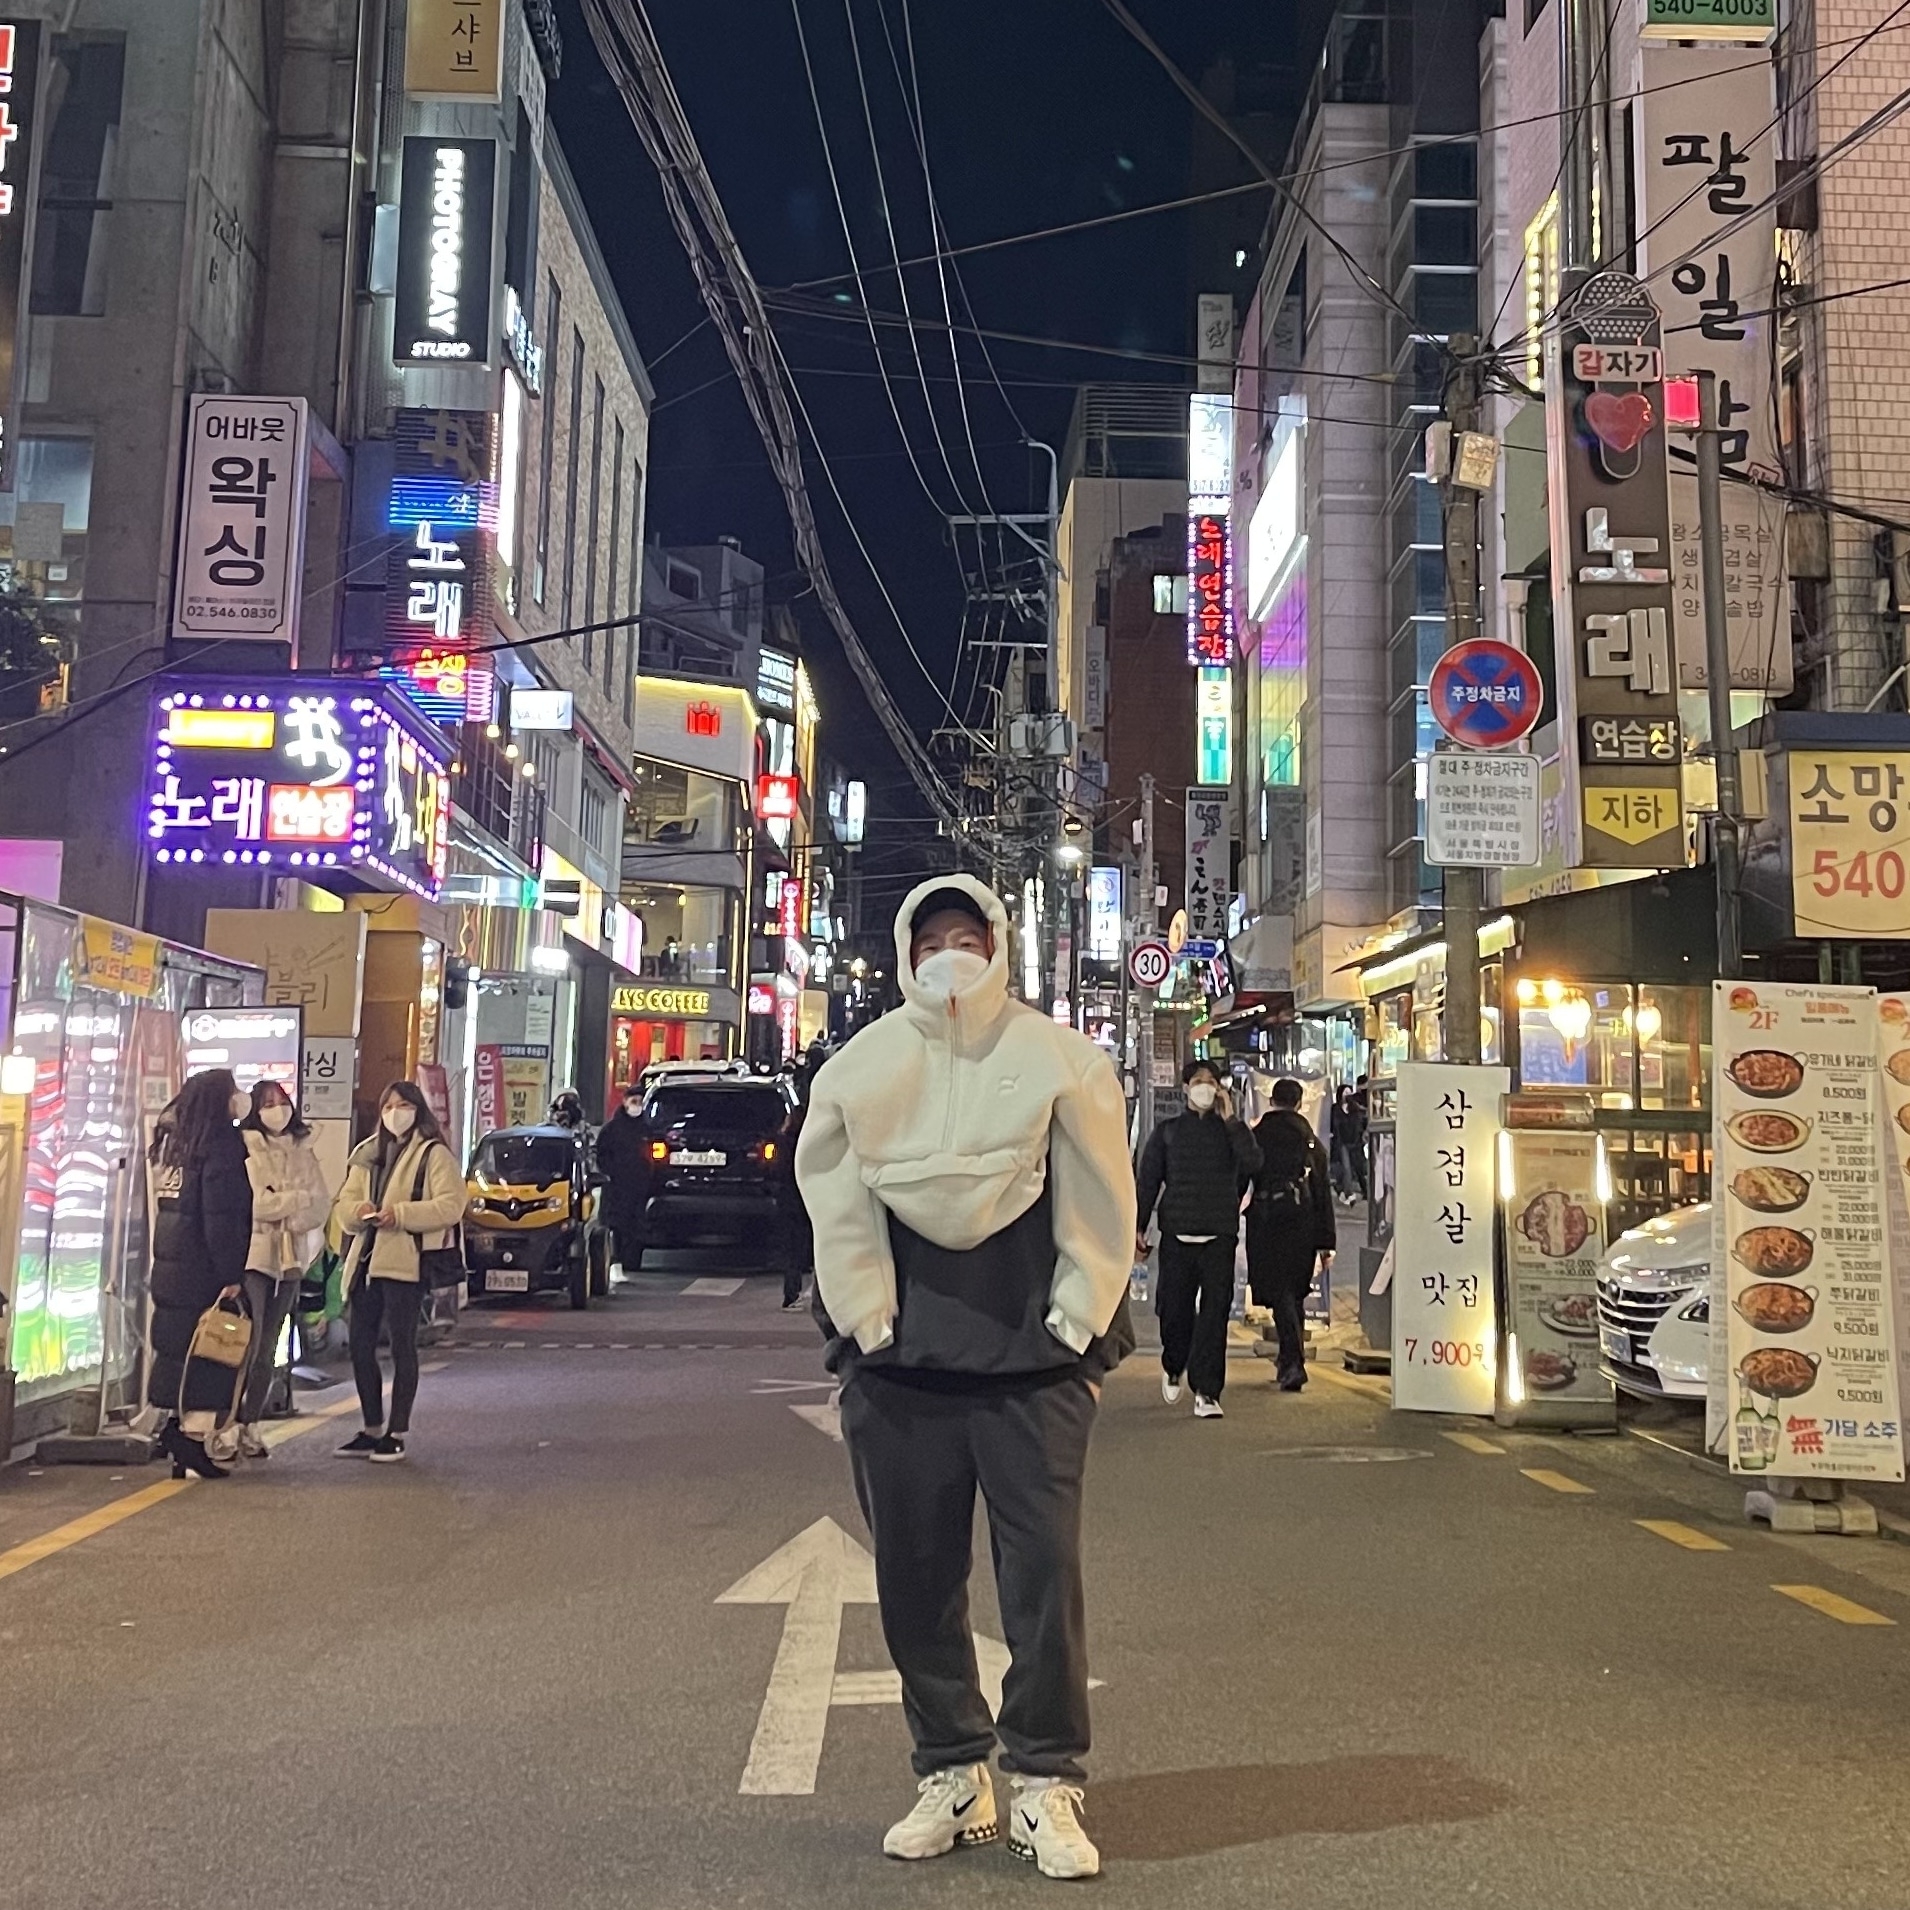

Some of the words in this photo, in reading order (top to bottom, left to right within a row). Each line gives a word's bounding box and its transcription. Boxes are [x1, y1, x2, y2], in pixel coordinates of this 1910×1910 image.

[1654, 0, 1768, 16] 540-4003
[449, 1, 481, 73] 샤브
[428, 147, 464, 336] PHOTOGRAY
[410, 341, 471, 358] STUDIO
[1578, 350, 1659, 378] 갑자기
[205, 415, 285, 442] 어바웃
[204, 456, 277, 587] 왁싱
[407, 520, 467, 638] 노래
[186, 605, 277, 619] 02.546.0830
[1579, 506, 1670, 695] 노래
[1450, 685, 1521, 703] 주정차금지
[1591, 720, 1679, 761] 연습장
[162, 774, 266, 841] 노래
[1601, 794, 1664, 829] 지하
[1812, 850, 1906, 899] 540
[1139, 952, 1162, 977] 30
[646, 988, 710, 1015] COFFEE
[1748, 1010, 1780, 1030] 2F
[1433, 1088, 1473, 1245] 삼겹살
[1421, 1271, 1478, 1308] 맛집
[1826, 1346, 1890, 1363] 낙지닭갈비
[1785, 1413, 1824, 1455] 無
[1863, 1419, 1899, 1440] 소주
